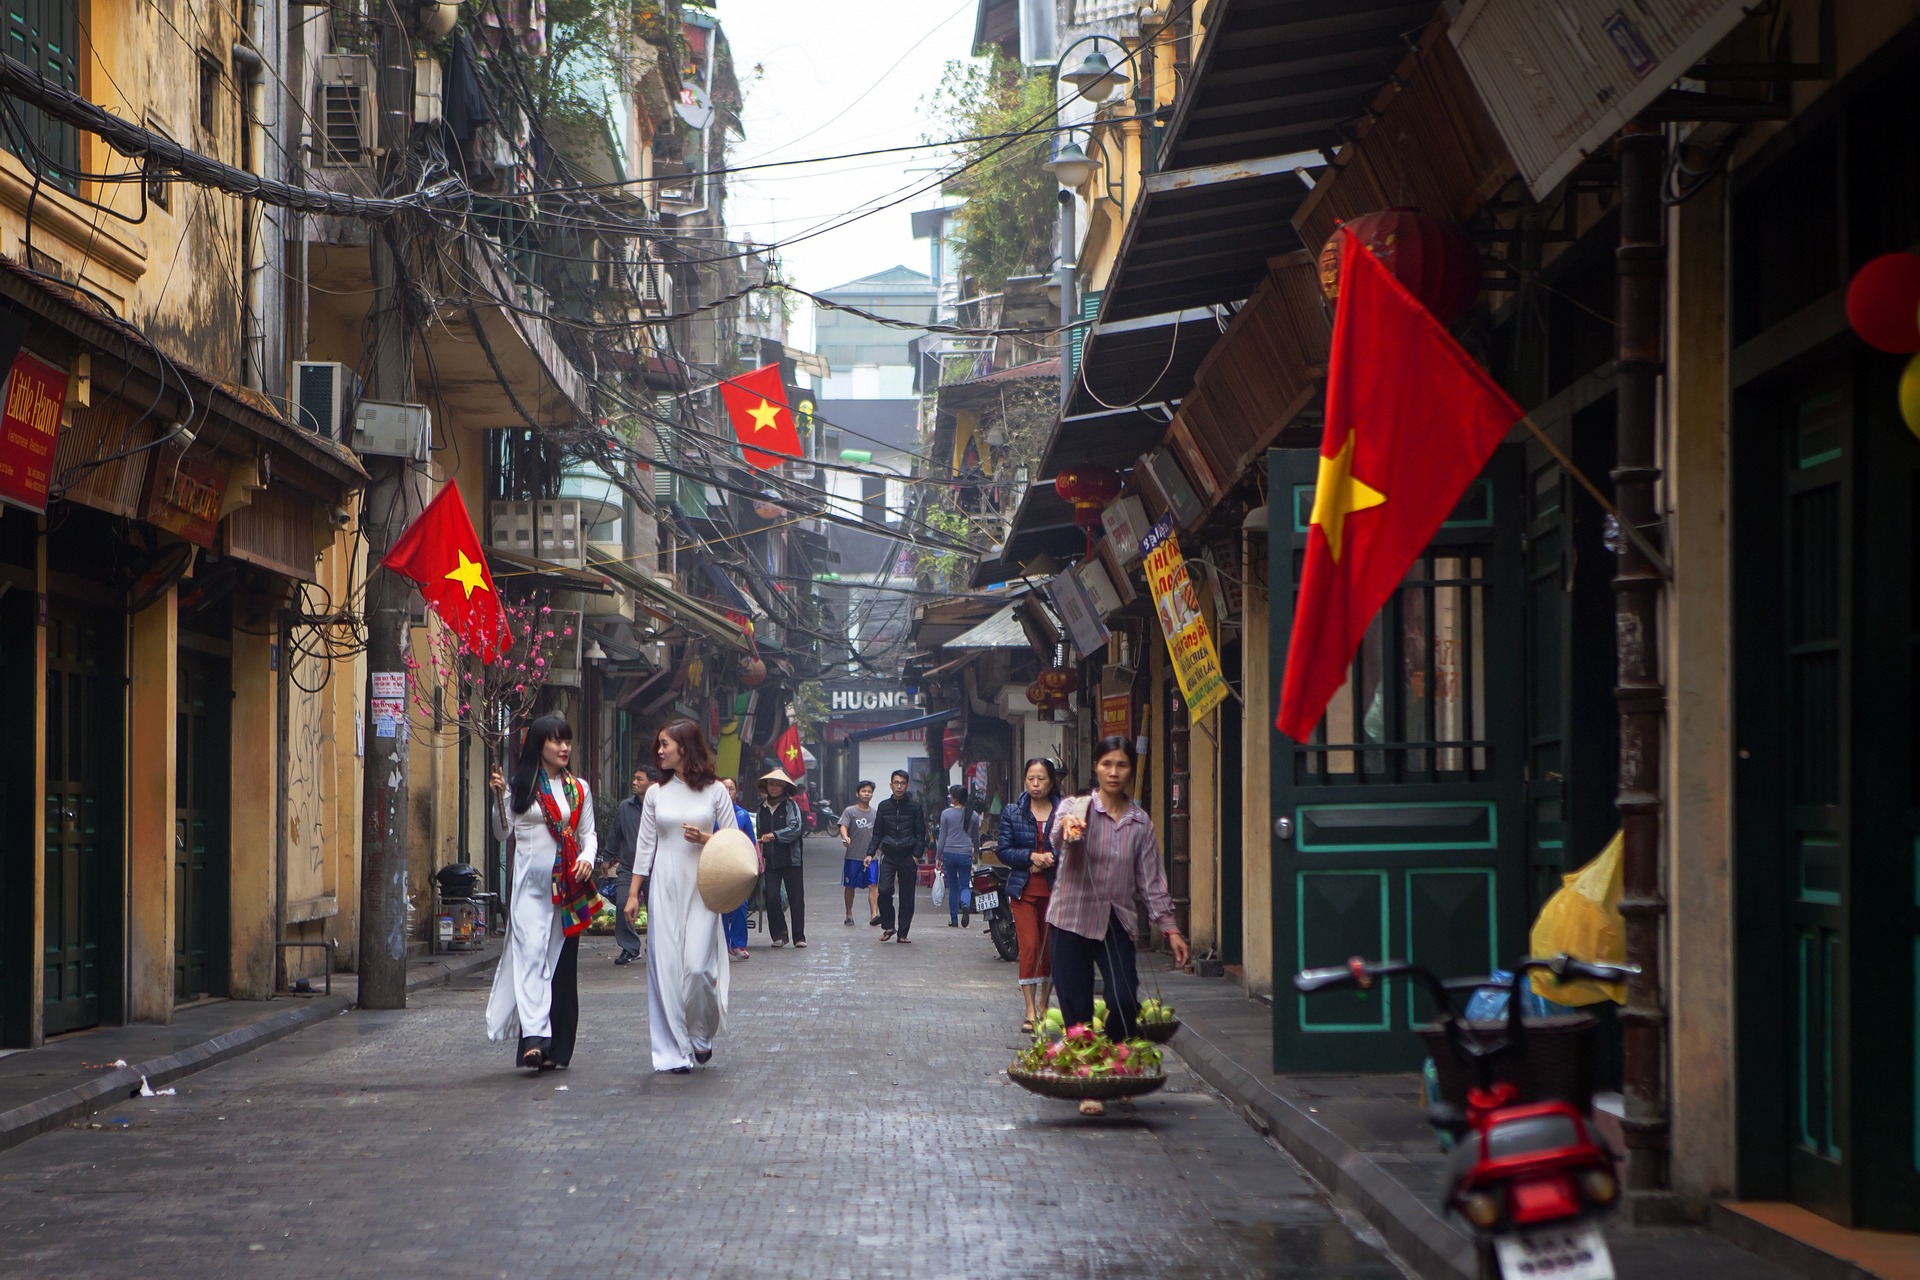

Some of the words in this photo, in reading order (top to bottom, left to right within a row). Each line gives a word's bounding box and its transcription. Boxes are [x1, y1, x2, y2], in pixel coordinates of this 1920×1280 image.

[7, 369, 34, 424] Little
[31, 380, 61, 437] Hanoi
[855, 818, 867, 826] DO
